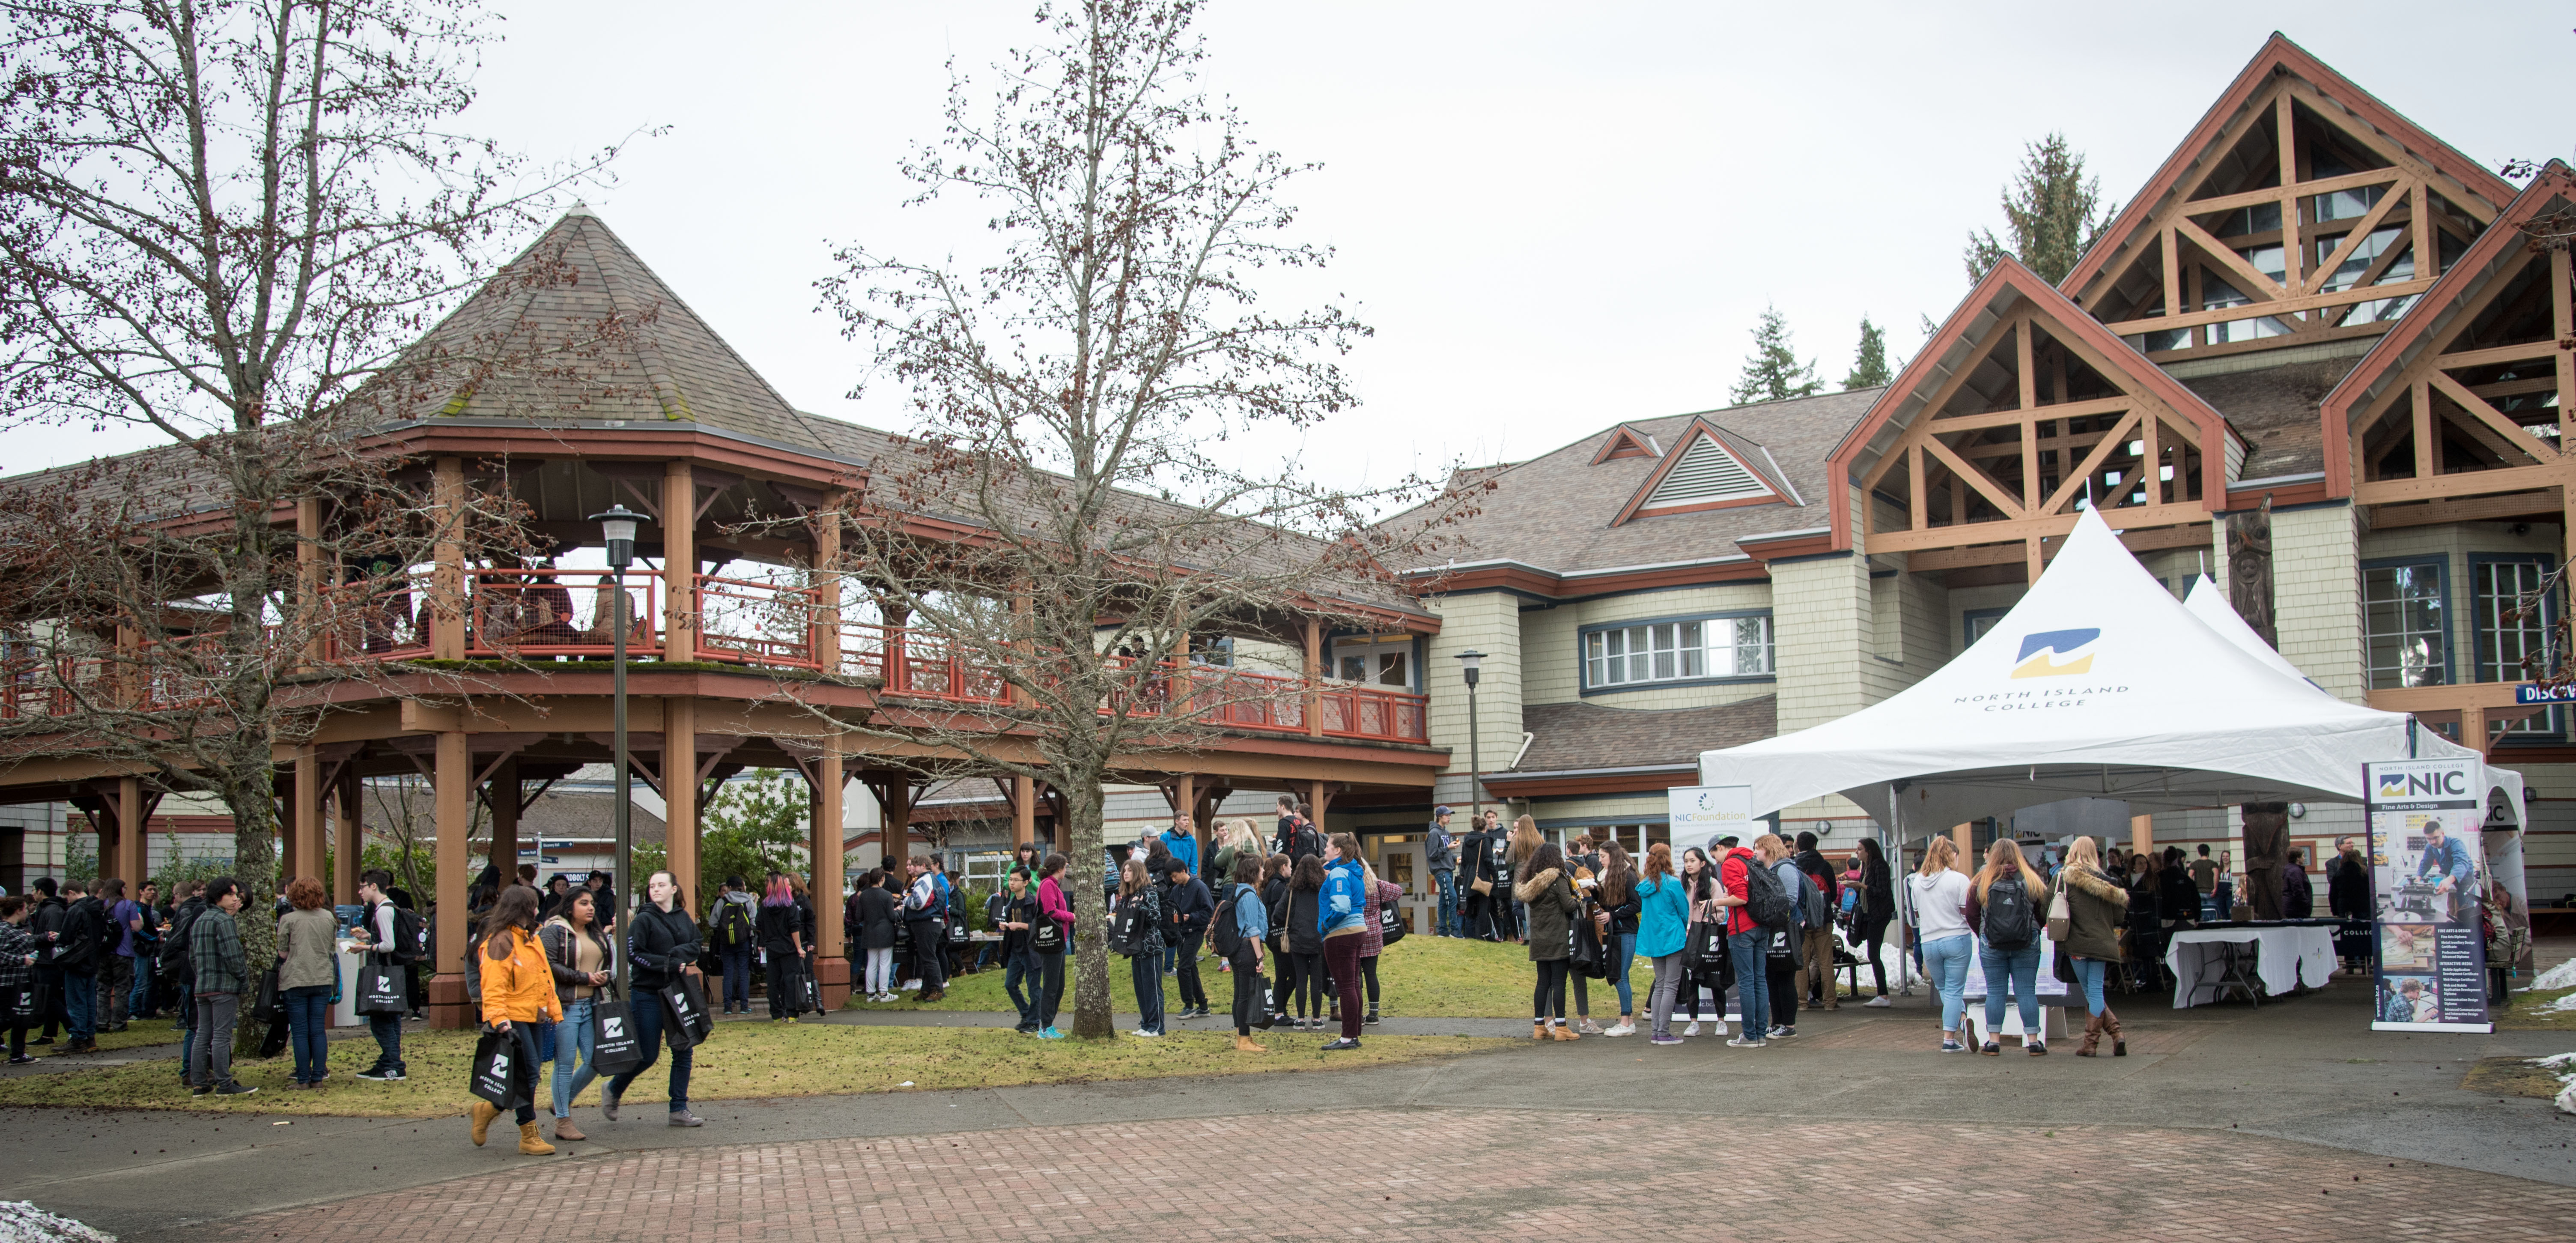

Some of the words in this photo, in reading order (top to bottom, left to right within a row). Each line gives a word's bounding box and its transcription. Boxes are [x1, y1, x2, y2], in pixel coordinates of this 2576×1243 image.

[1954, 692, 2031, 703] NORTH
[2044, 686, 2129, 697] ISLAND
[1984, 699, 2086, 711] COLLEGE
[2408, 771, 2465, 796] NIC
[1675, 812, 1746, 822] NICFoundation
[2487, 805, 2504, 822] IC
[564, 873, 585, 881] ADBOLT
[479, 1075, 494, 1085] NORTH
[494, 1082, 506, 1091] ISLA
[484, 1083, 503, 1095] COLLEGE
